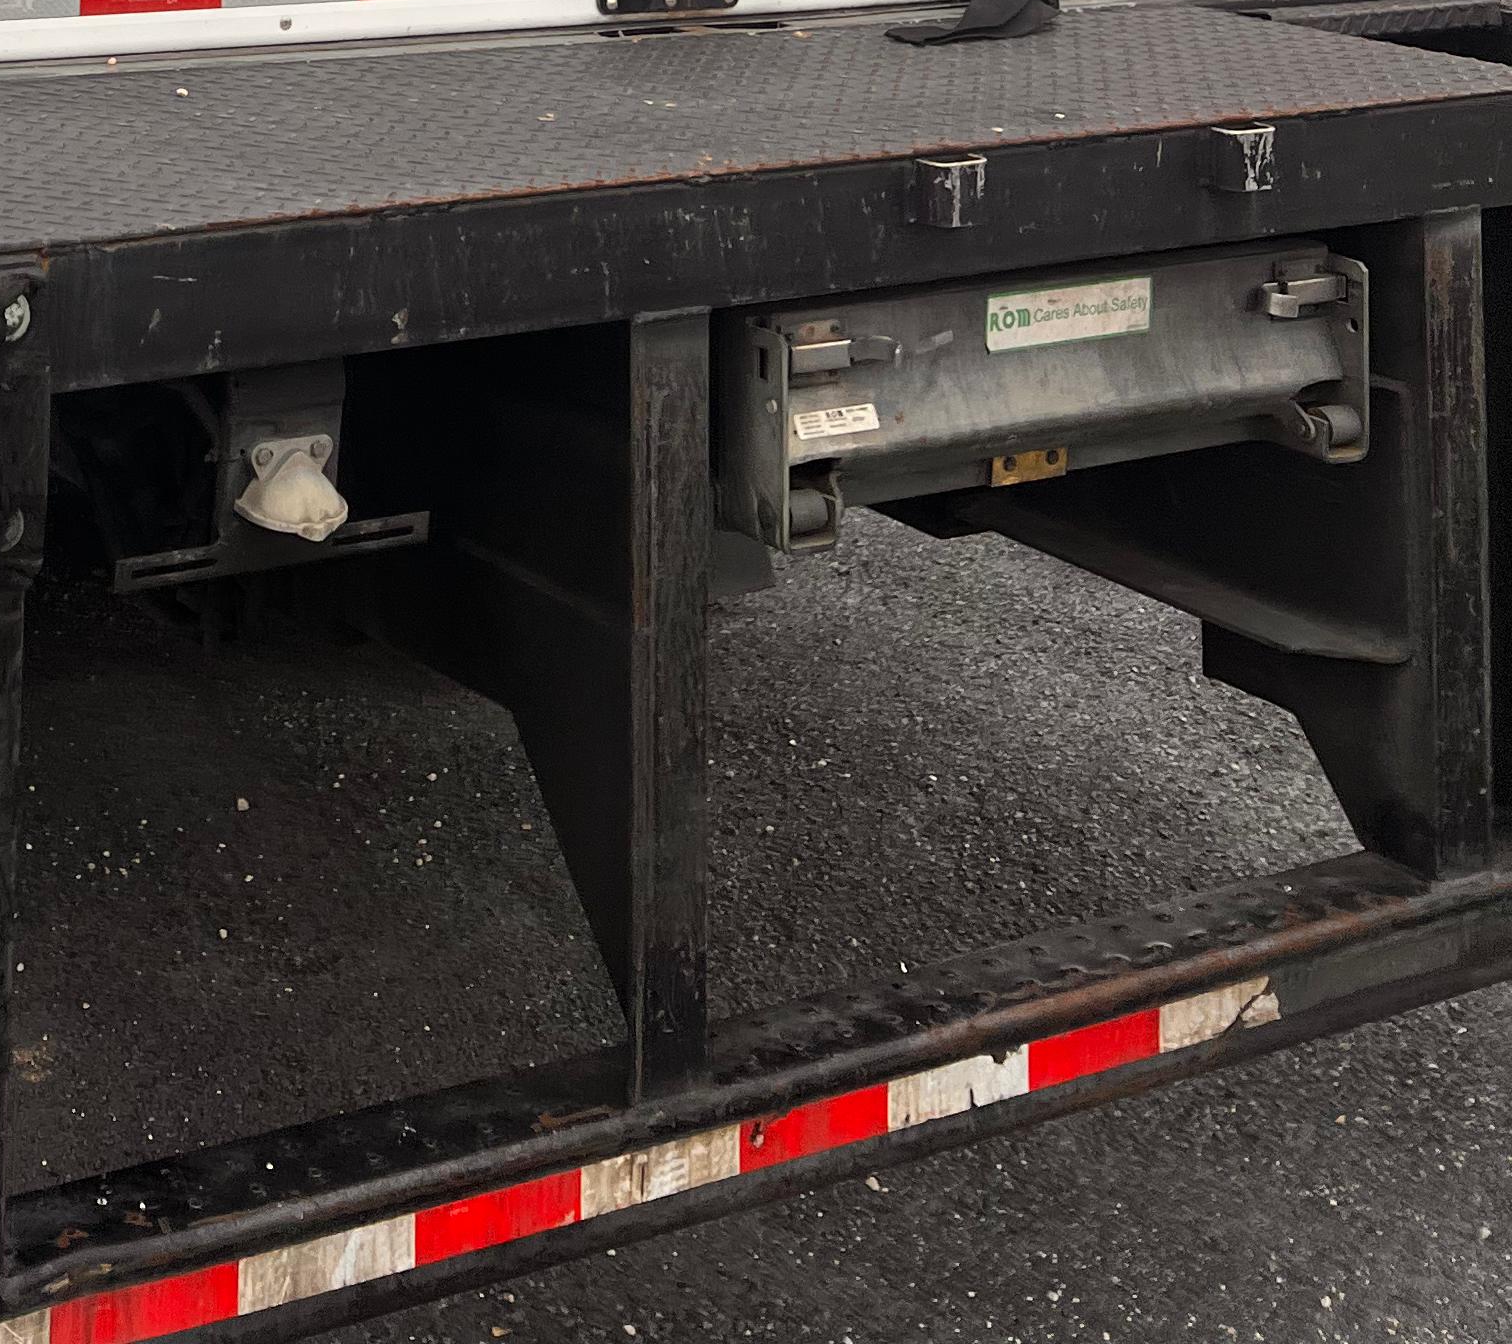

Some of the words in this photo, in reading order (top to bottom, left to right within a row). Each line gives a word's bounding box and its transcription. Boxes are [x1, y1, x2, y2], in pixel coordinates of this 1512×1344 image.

[1033, 307, 1070, 323] Cares
[1073, 301, 1109, 317] About
[1111, 294, 1149, 312] Safety
